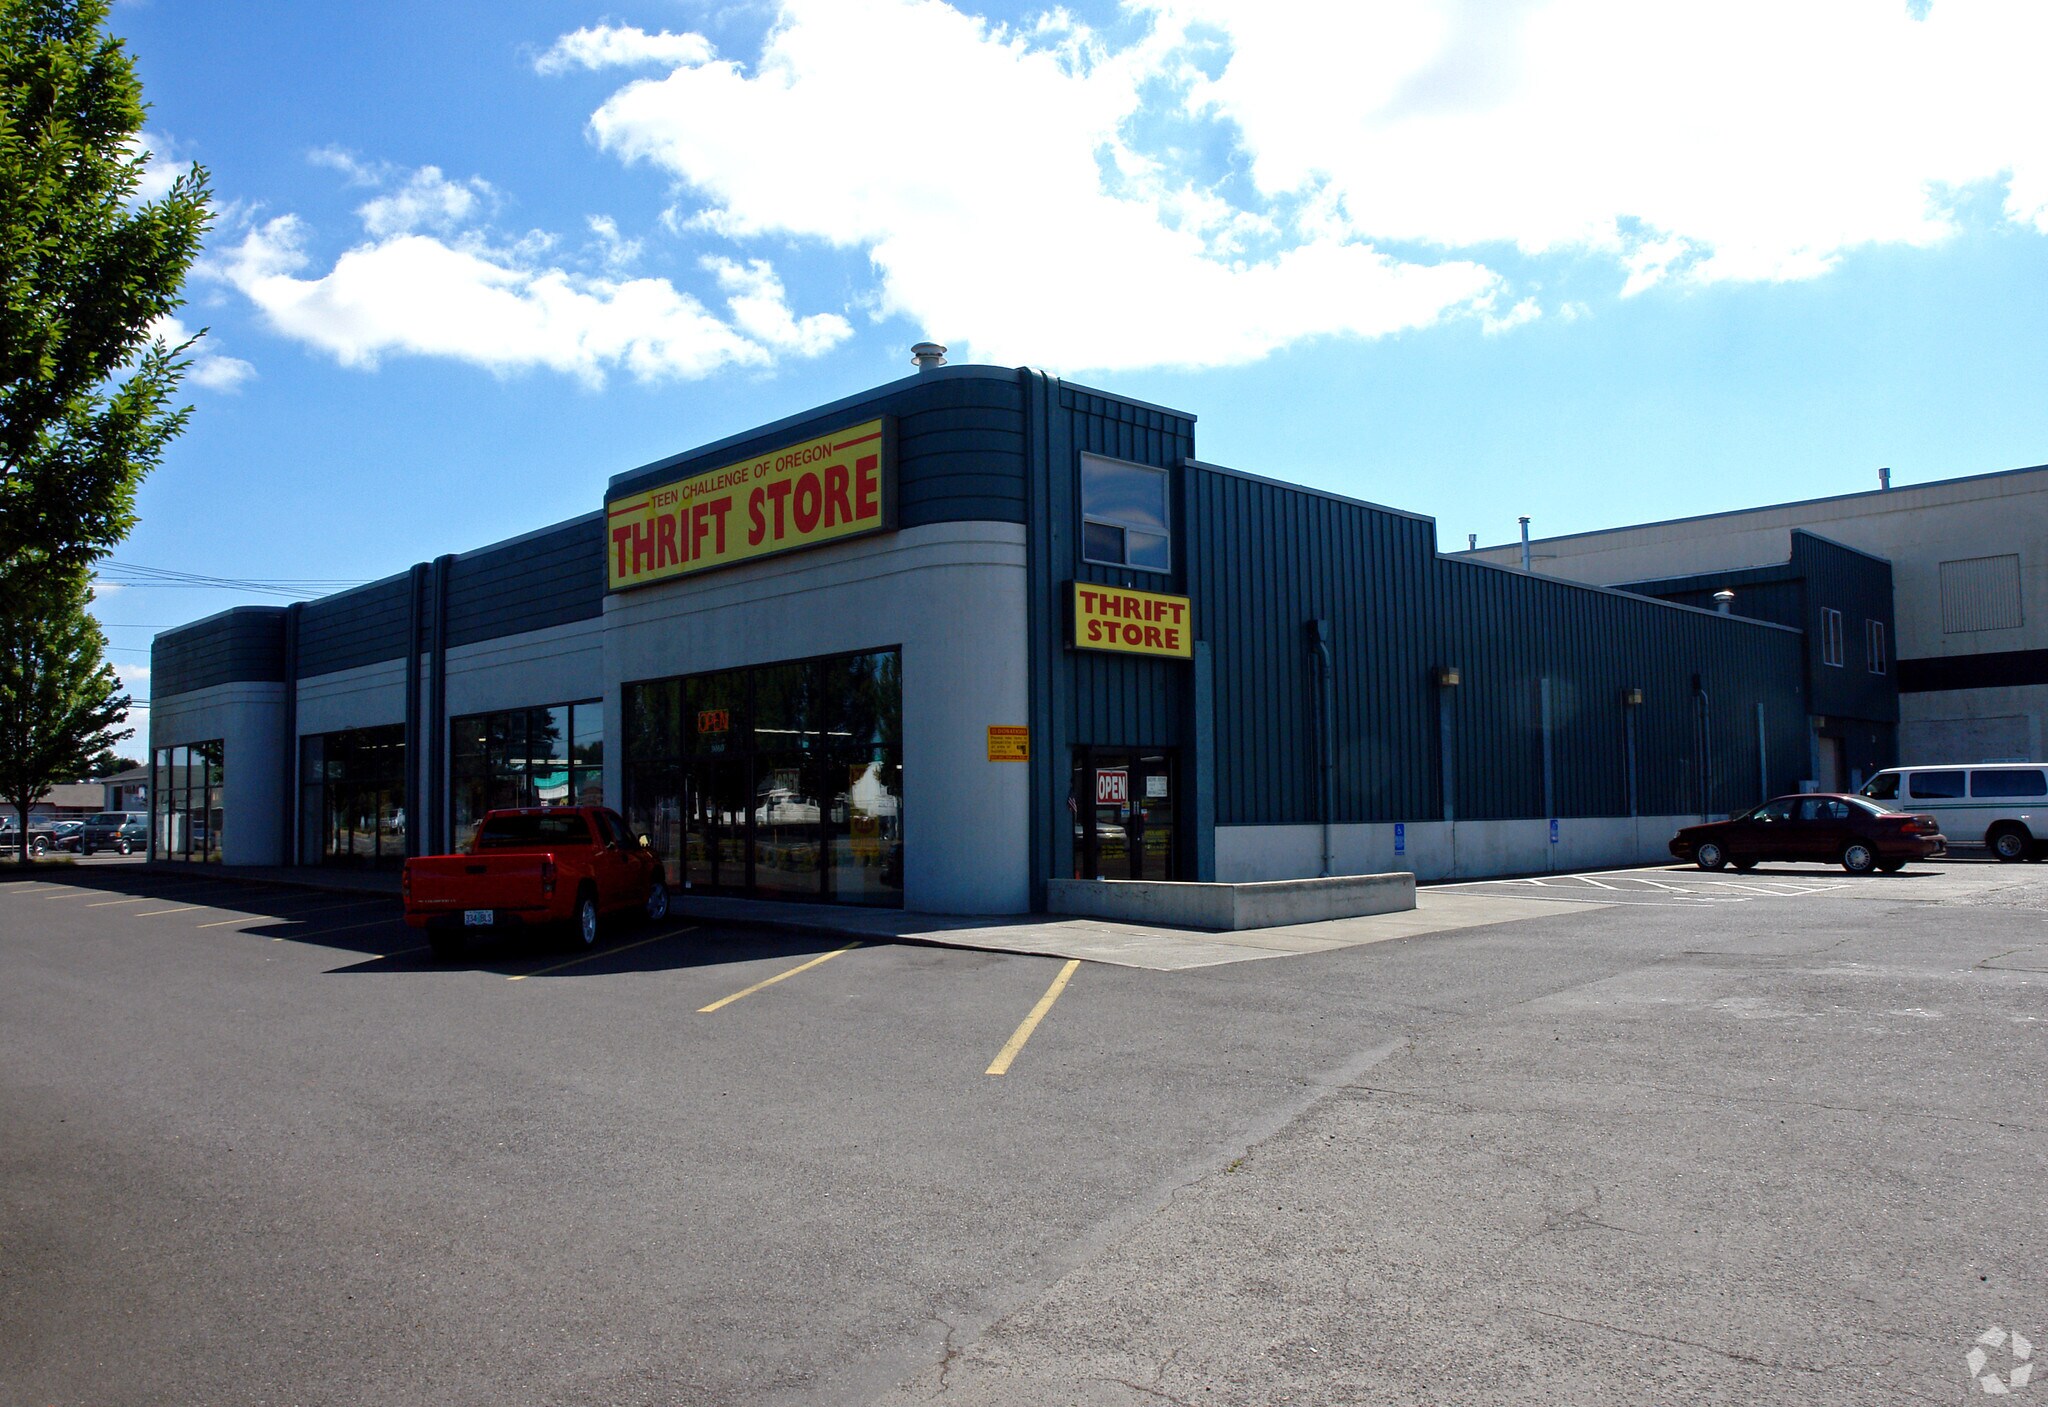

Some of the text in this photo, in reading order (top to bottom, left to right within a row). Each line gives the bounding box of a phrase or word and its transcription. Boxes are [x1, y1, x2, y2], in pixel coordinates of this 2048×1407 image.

[651, 442, 833, 509] TEEN CHALLENGE OF OREGON
[612, 453, 879, 579] THRIFT STORE
[1079, 591, 1185, 624] THRIFT
[1088, 619, 1179, 649] STORE
[700, 711, 728, 732] OPEN
[1098, 775, 1126, 800] OPEN
